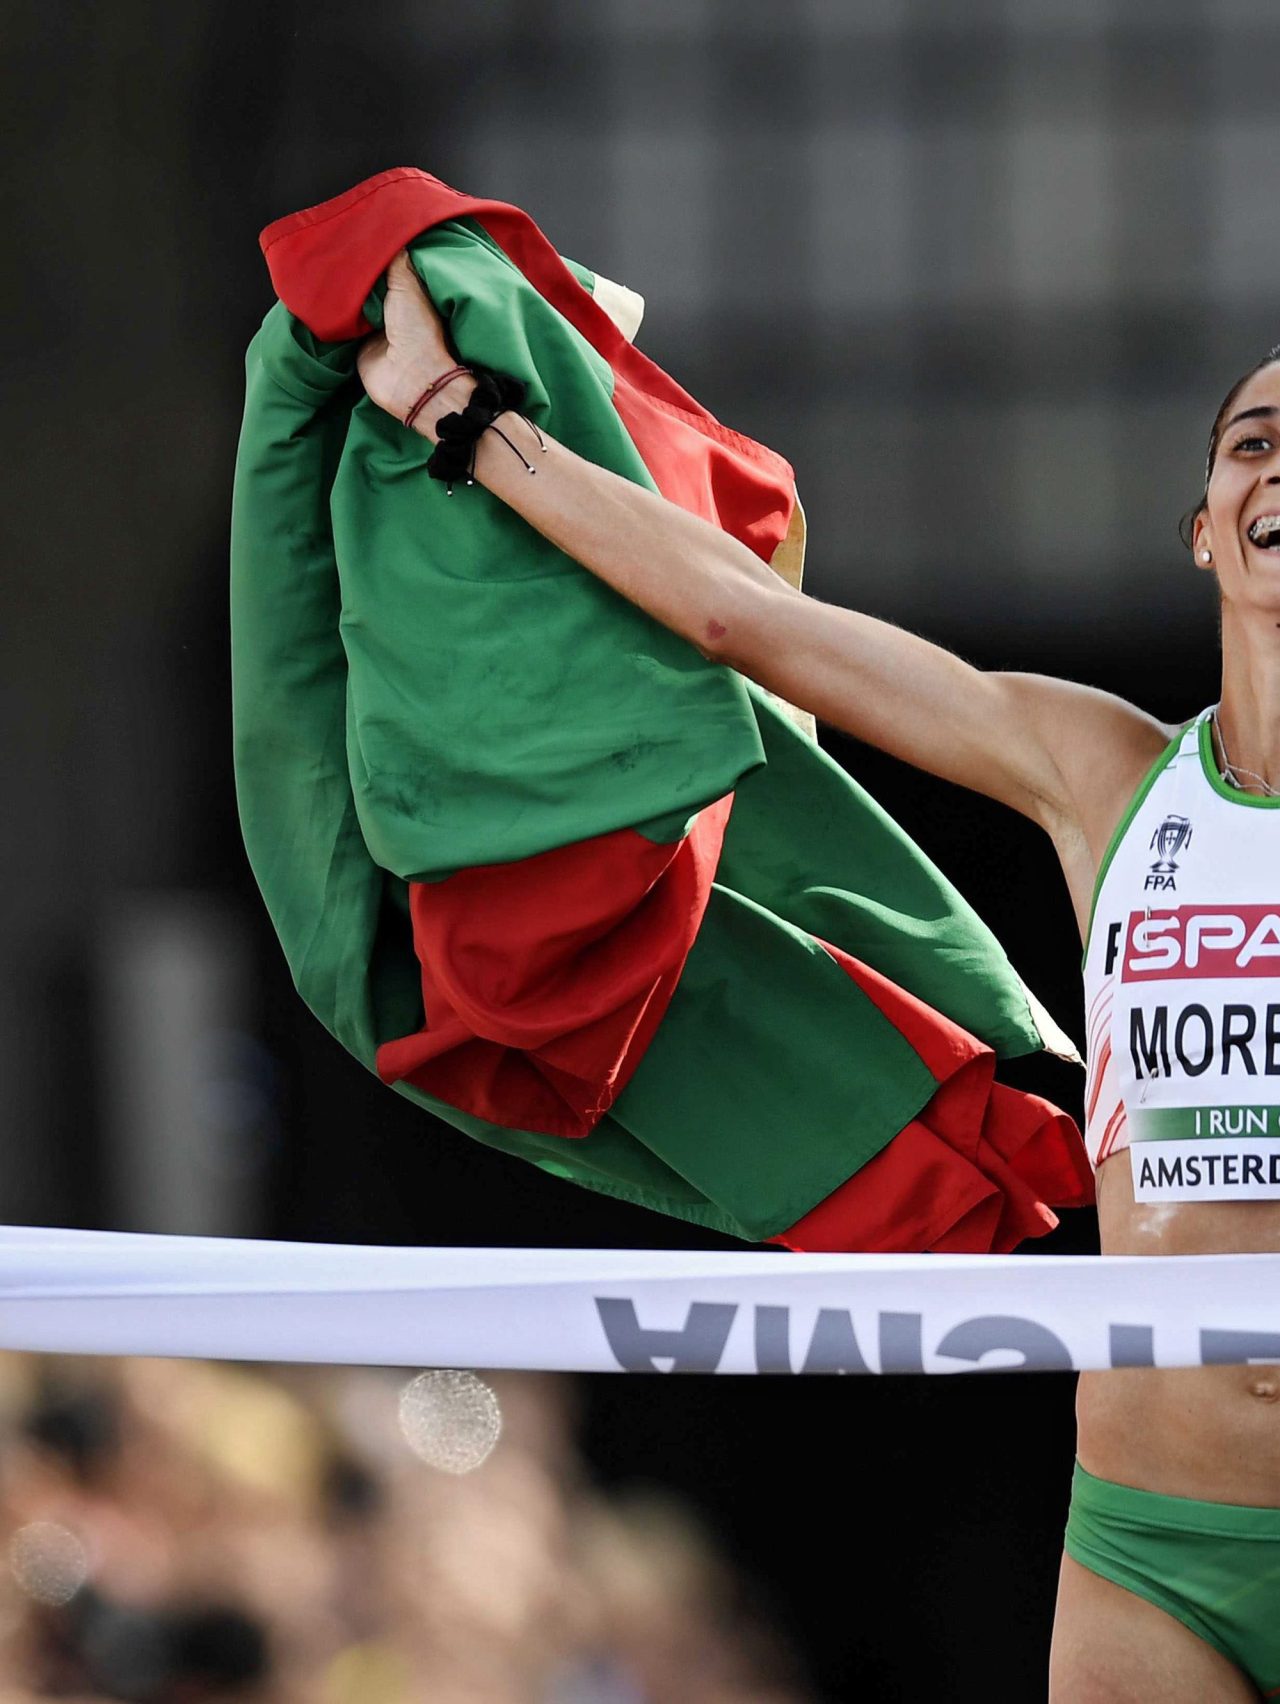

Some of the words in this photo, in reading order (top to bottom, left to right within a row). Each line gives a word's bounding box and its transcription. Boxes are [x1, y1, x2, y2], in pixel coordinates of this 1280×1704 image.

[1144, 875, 1176, 891] FPA
[1195, 1110, 1201, 1135] I
[1209, 1110, 1268, 1134] RUN
